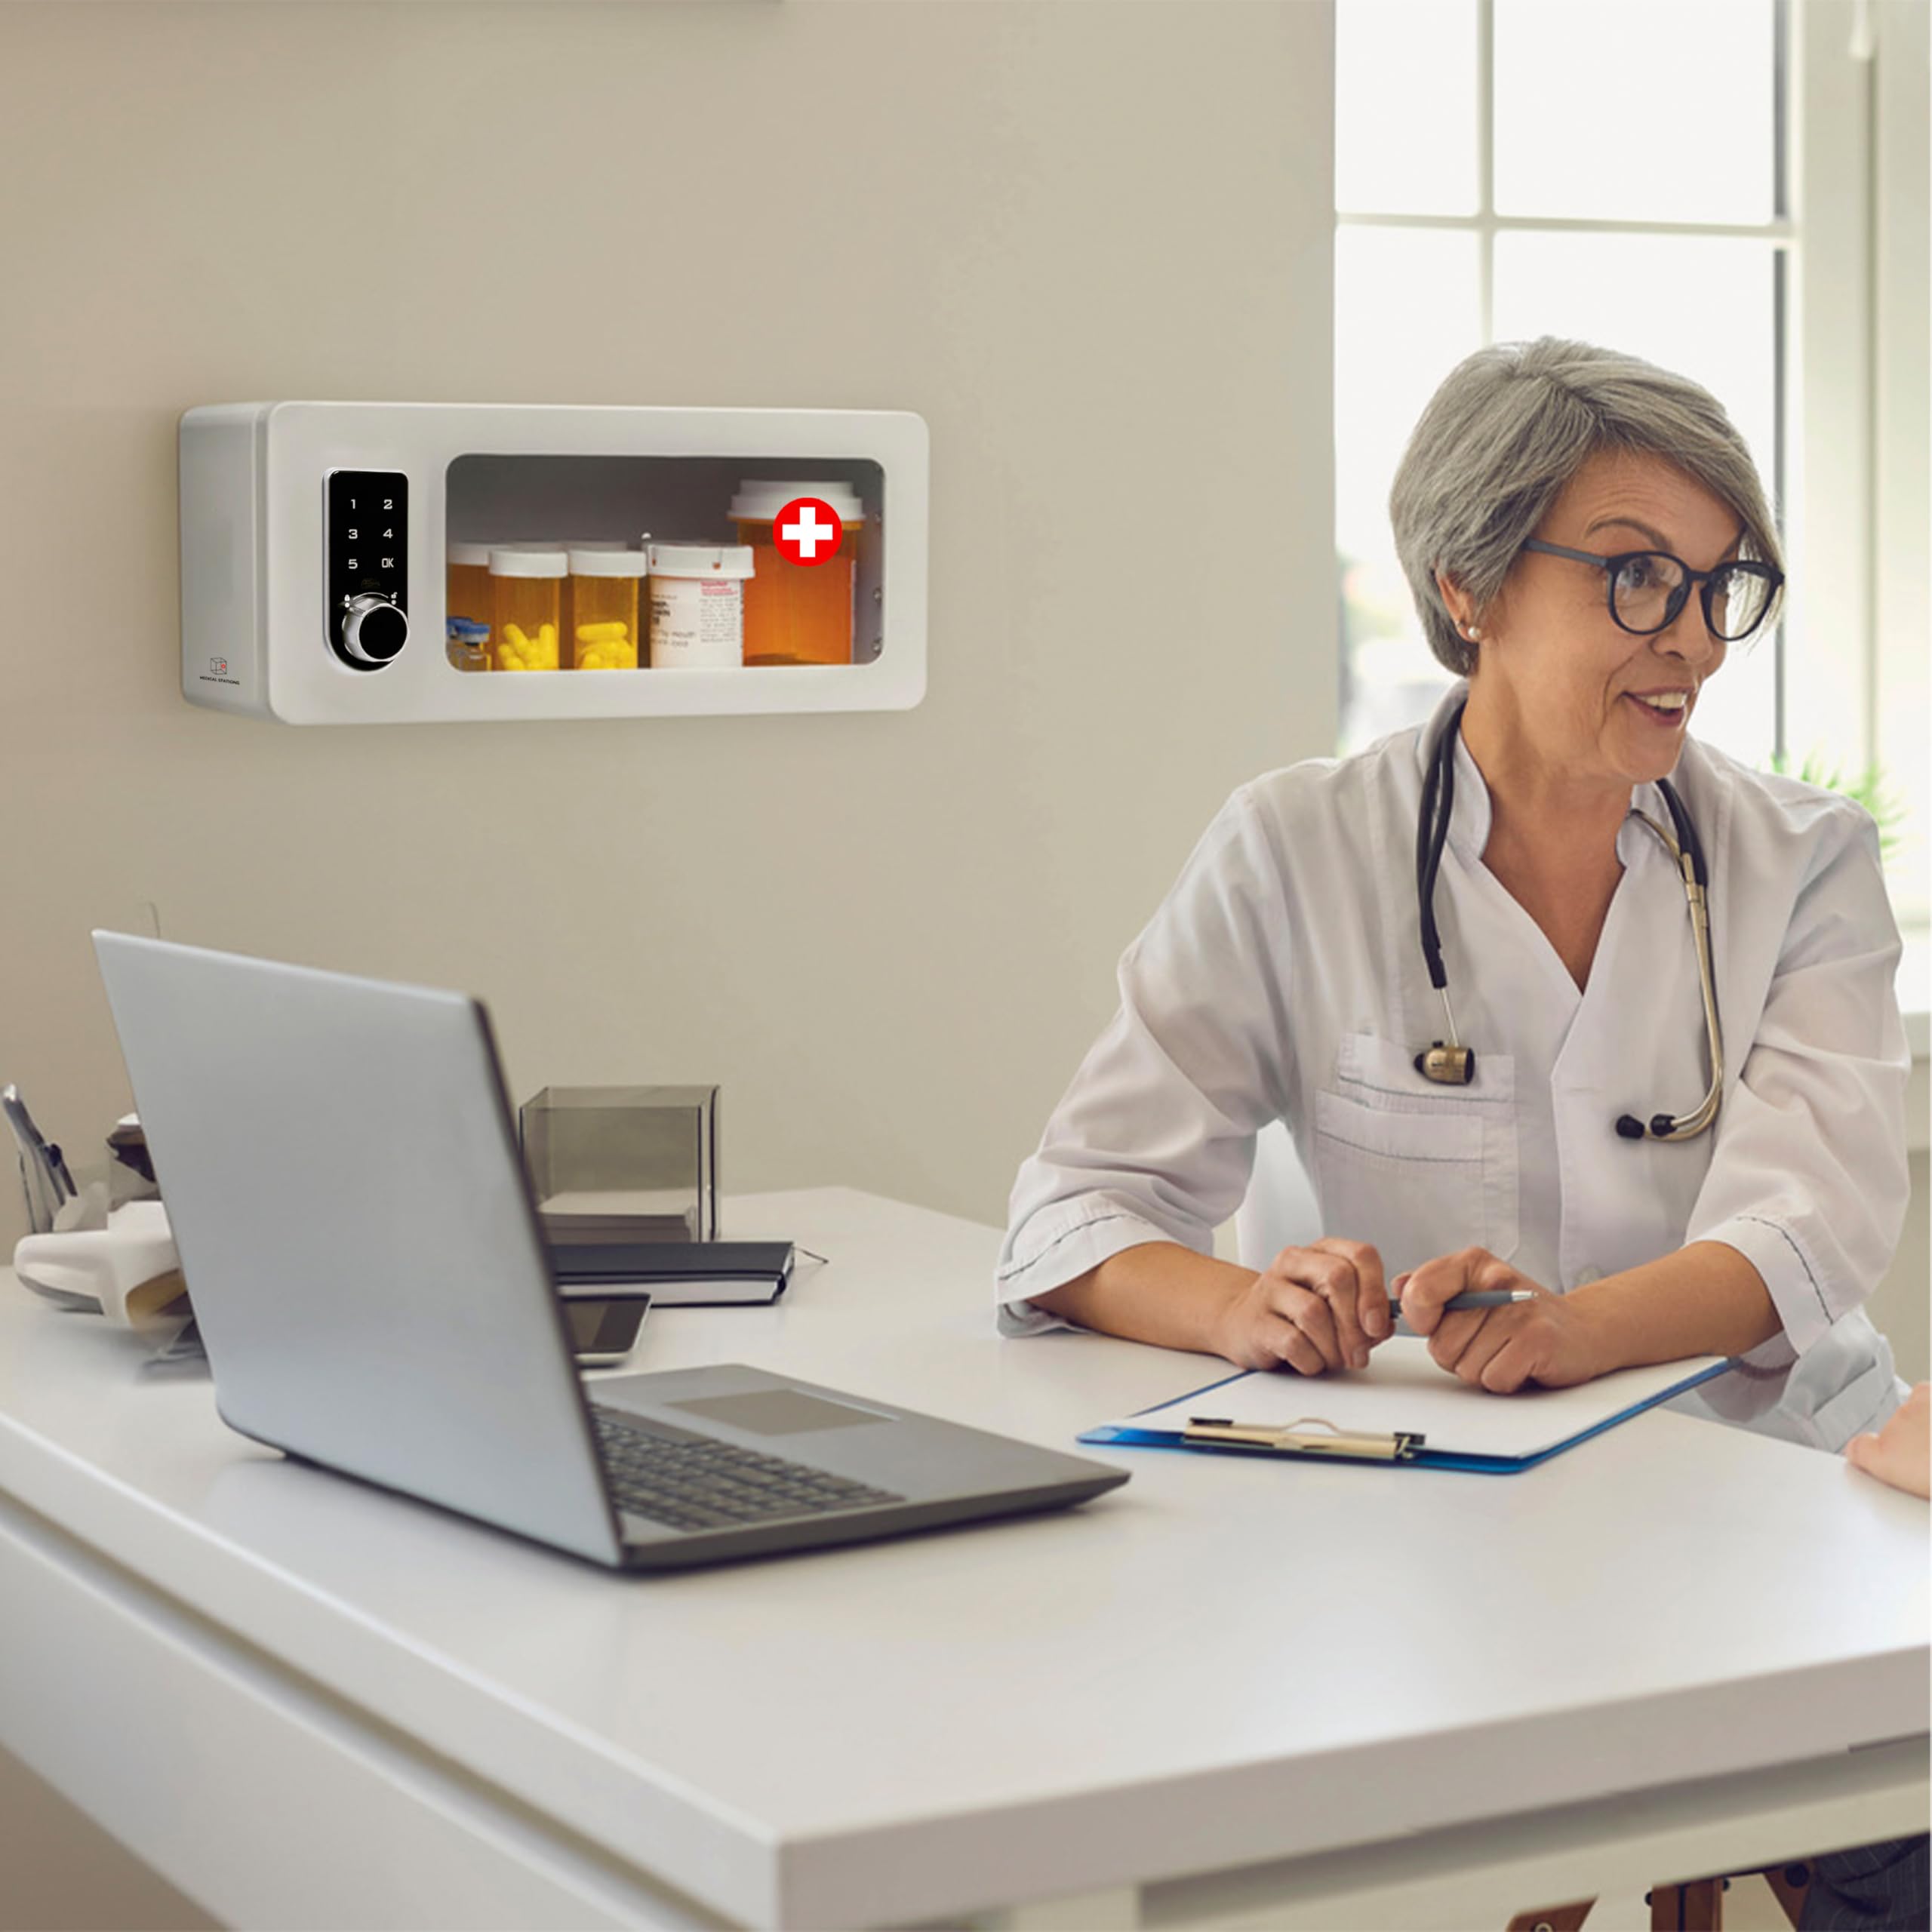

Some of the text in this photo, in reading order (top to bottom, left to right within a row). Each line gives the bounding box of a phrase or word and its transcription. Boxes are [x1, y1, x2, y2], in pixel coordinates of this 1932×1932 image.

[350, 499, 393, 510] 1 2
[348, 528, 393, 540] 3 4
[348, 558, 394, 570] 5 OK
